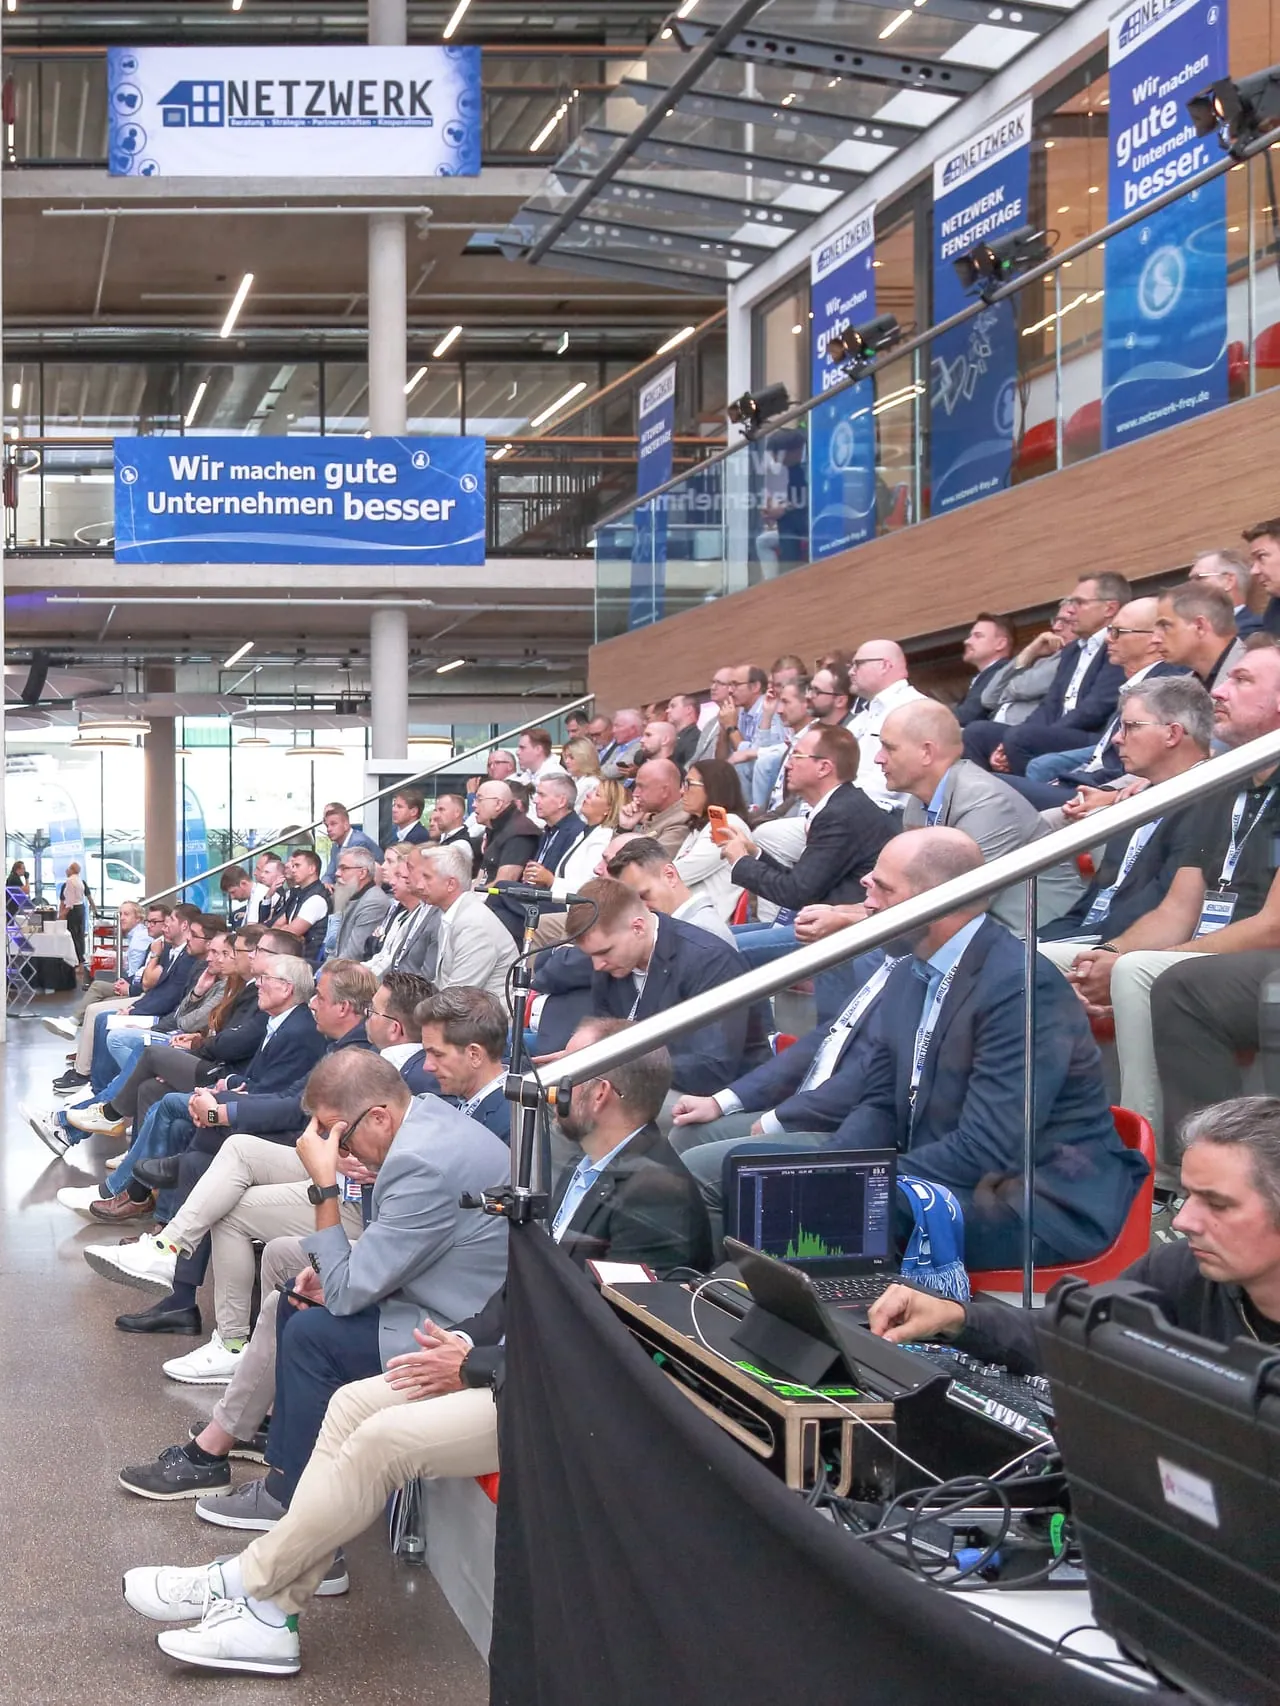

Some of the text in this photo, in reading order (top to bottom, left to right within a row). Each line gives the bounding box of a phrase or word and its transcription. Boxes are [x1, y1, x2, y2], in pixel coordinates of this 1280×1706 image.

[228, 79, 433, 116] NETZWERK
[1132, 54, 1209, 106] Wir machen
[231, 119, 265, 127] Beratung
[961, 115, 1025, 167] NETZWERK
[1116, 100, 1178, 167] gute
[1123, 143, 1210, 210] besser.
[941, 185, 1006, 238] NETZWERK
[941, 198, 1022, 260] FENSTERTAGE
[825, 289, 868, 317] Wir machen
[1116, 390, 1210, 433] www.netzwerk-frey.de
[168, 454, 397, 489] Wir machen gute
[147, 491, 456, 521] Unternehmen besser
